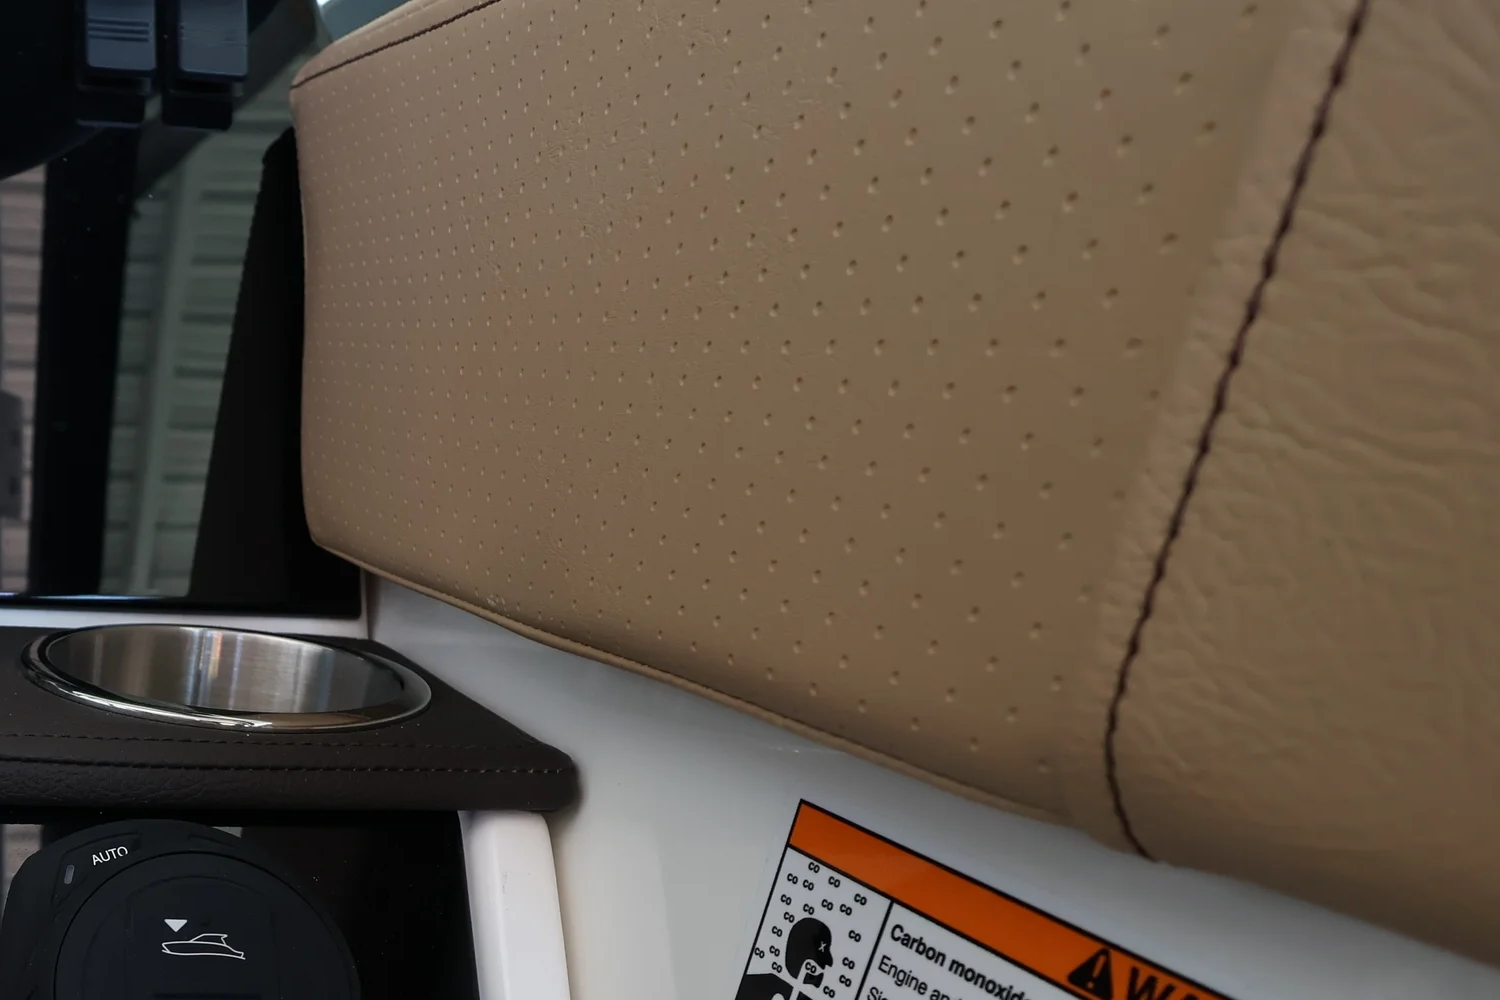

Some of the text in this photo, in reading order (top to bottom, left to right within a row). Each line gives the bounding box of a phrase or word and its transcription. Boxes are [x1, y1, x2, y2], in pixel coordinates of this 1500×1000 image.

[92, 846, 128, 865] AUTO
[807, 861, 821, 874] CO
[828, 875, 842, 889] CO
[891, 924, 947, 966] Carbon
[878, 954, 928, 996] Engine
